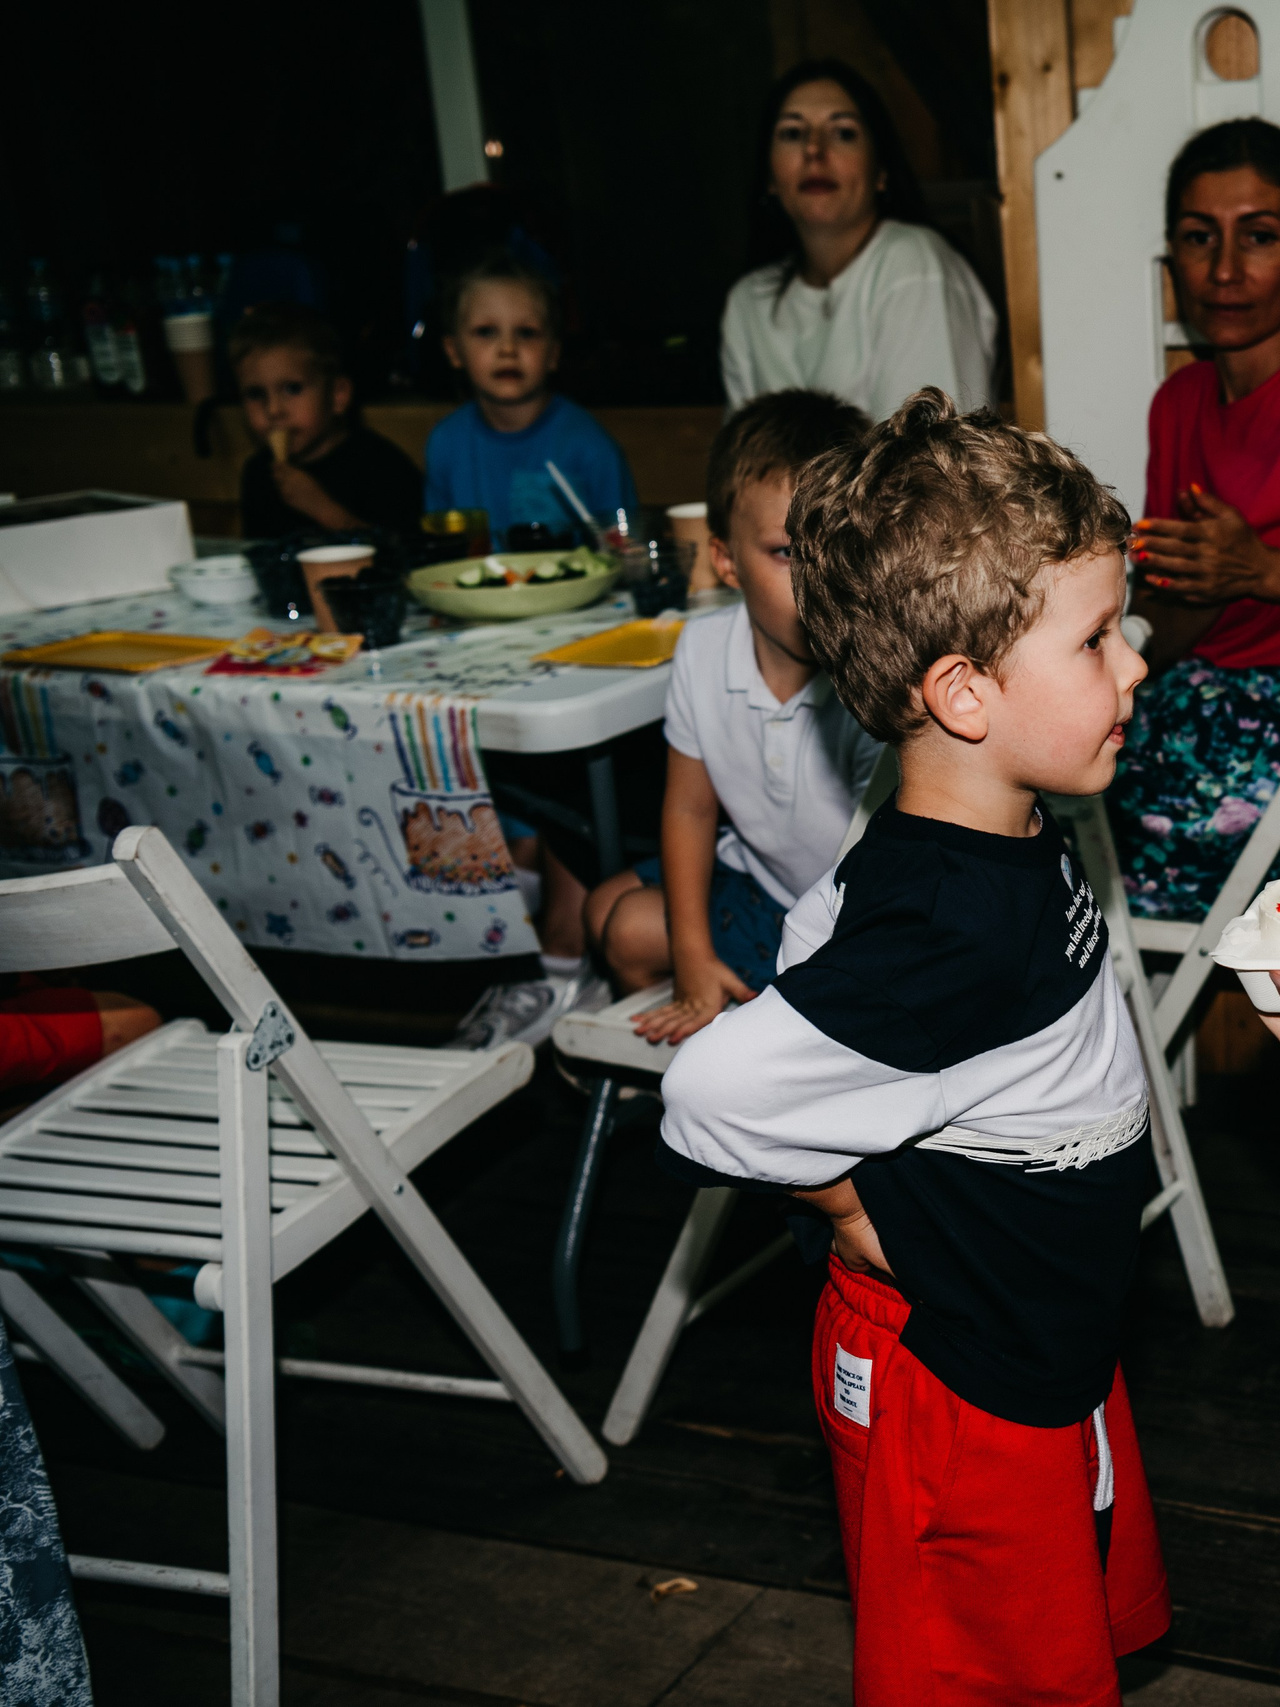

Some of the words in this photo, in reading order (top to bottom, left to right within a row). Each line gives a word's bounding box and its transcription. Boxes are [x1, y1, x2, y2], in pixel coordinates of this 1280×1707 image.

[1069, 926, 1083, 946] feel
[1065, 943, 1076, 963] you
[1078, 947, 1090, 969] and
[1086, 931, 1100, 953] thirst
[847, 1381, 866, 1391] SPEAKS
